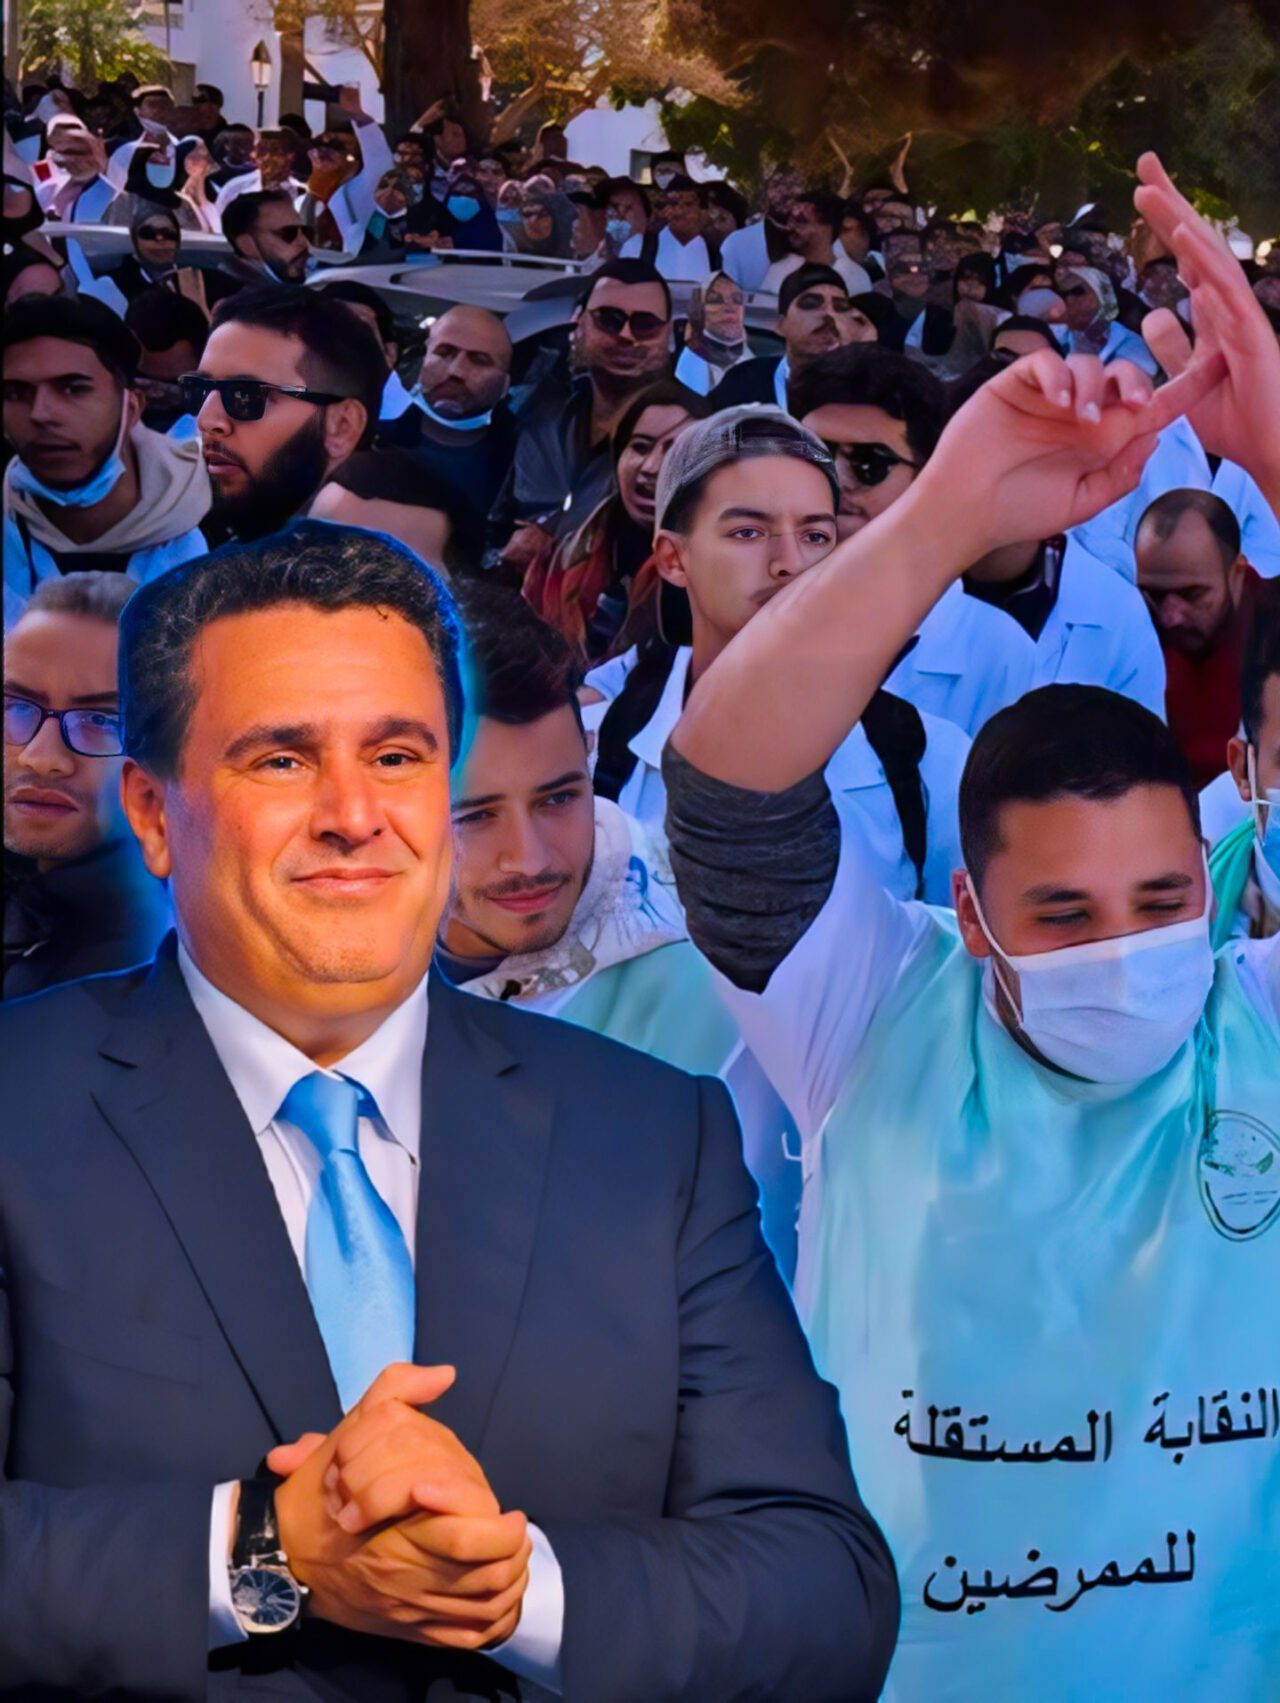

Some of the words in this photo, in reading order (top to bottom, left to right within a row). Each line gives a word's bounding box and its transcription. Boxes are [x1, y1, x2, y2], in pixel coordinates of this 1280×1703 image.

[893, 1389, 1113, 1463] المستقلة
[1143, 1387, 1280, 1465] النقابة
[922, 1528, 1197, 1615] للممرضين
